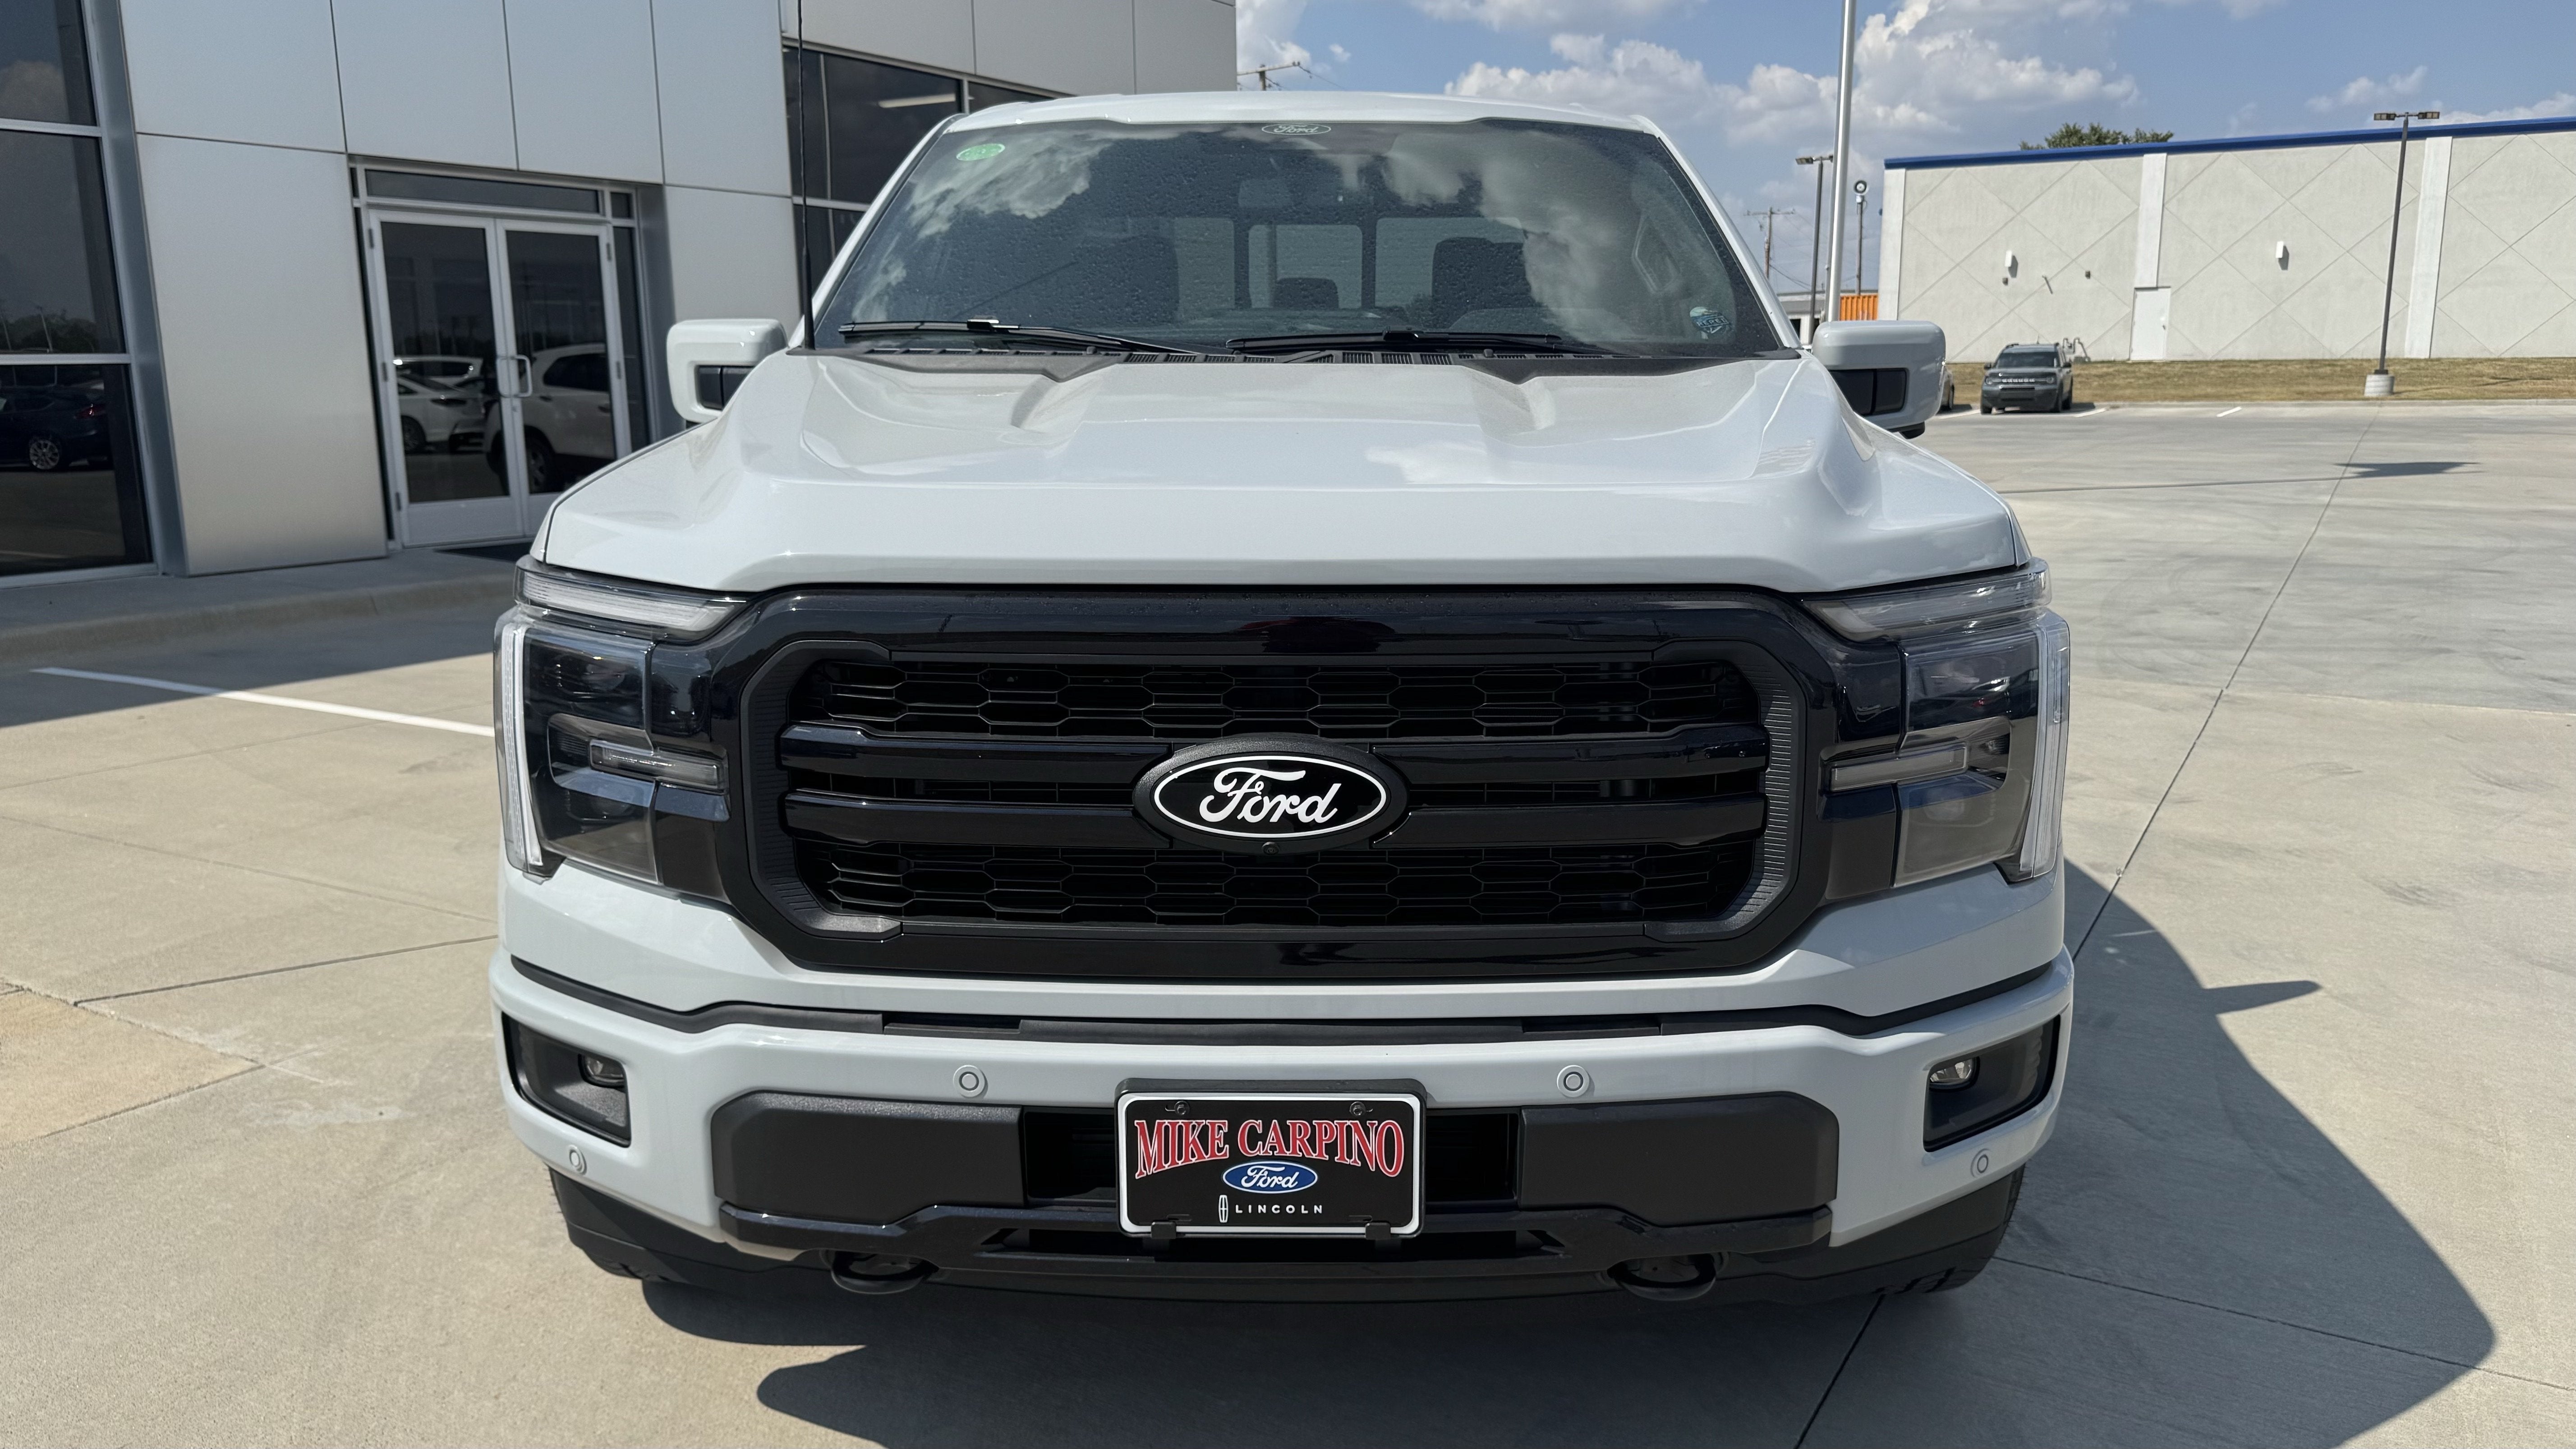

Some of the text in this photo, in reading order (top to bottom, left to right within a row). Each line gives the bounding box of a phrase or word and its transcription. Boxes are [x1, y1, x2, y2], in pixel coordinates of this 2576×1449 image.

[1274, 124, 1319, 133] Ford
[1199, 767, 1342, 823] Ford
[1134, 1119, 1404, 1179] MIKE CARPINO
[1241, 1165, 1299, 1188] Ford
[1235, 1205, 1323, 1214] LINCOLN
